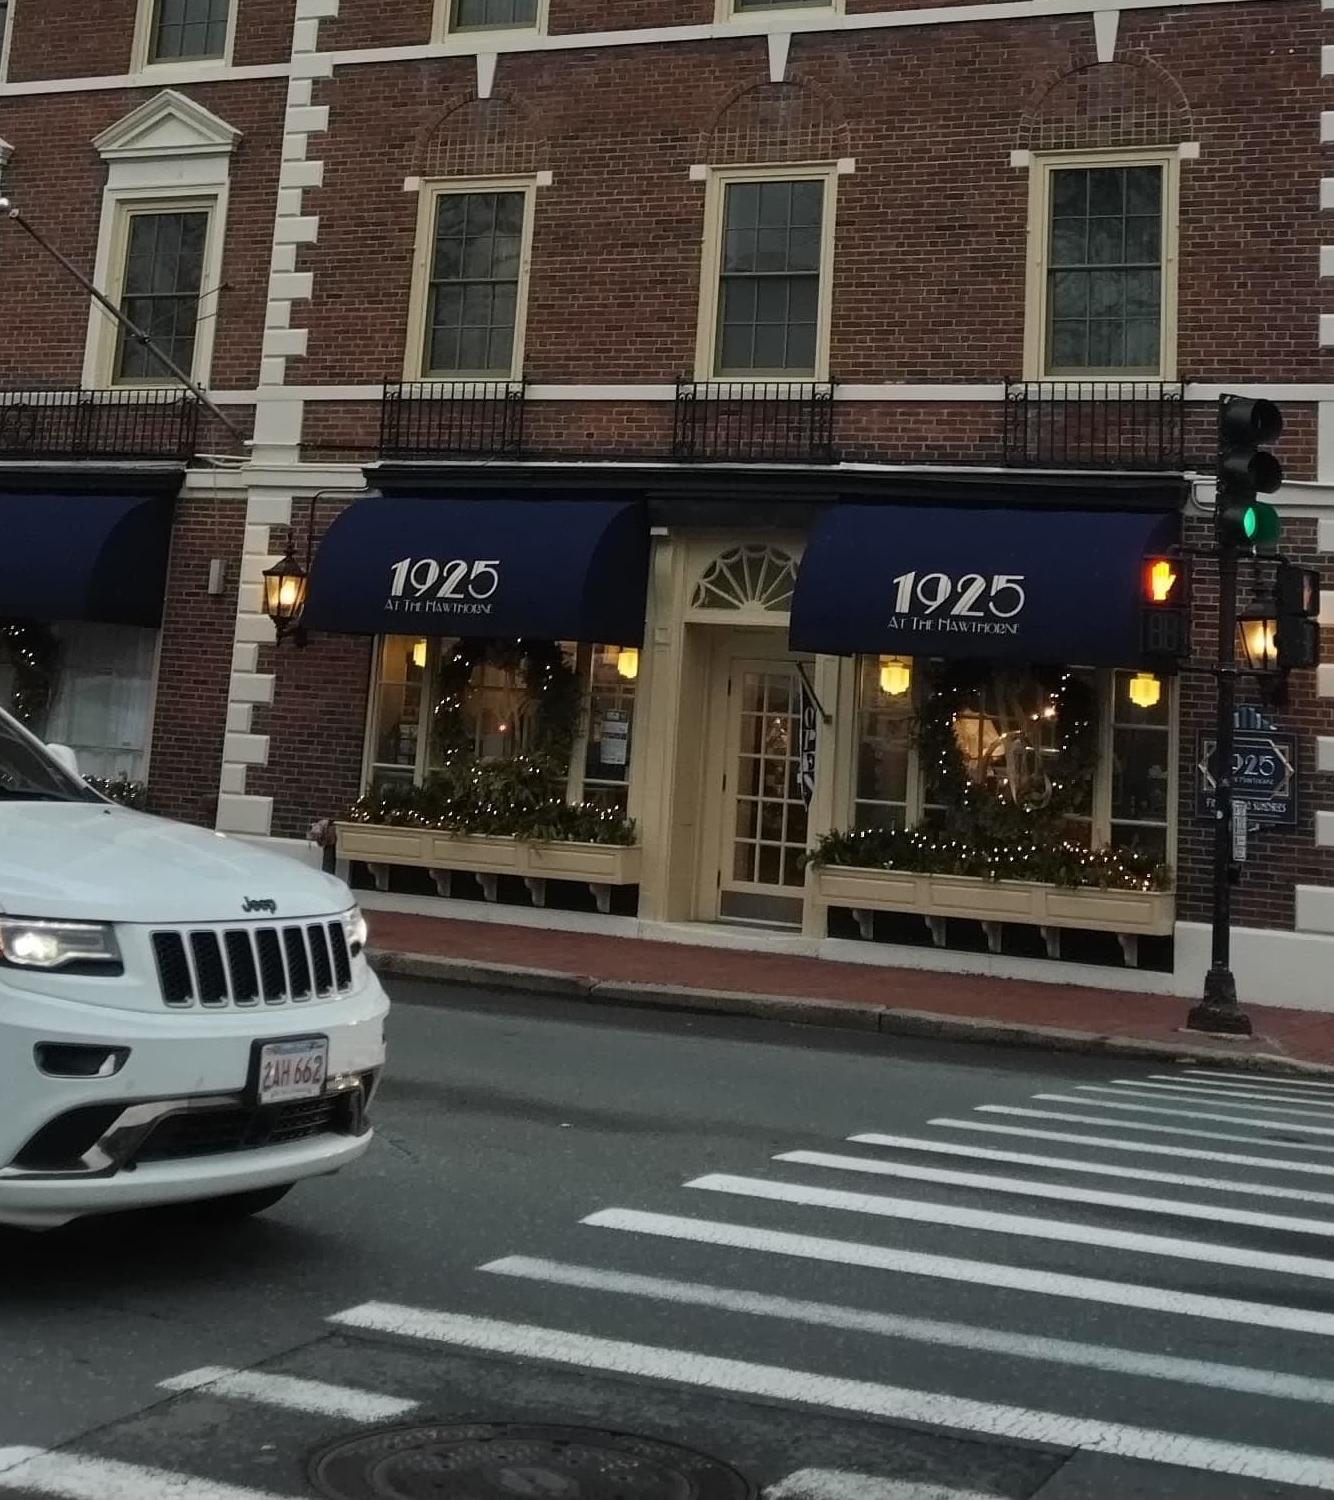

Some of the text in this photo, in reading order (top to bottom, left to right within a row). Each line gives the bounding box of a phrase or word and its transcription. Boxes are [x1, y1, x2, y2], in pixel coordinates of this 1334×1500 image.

[391, 557, 500, 599] 1925
[892, 571, 1025, 618] 1925
[1232, 753, 1276, 776] 925
[241, 895, 277, 915] Jeep
